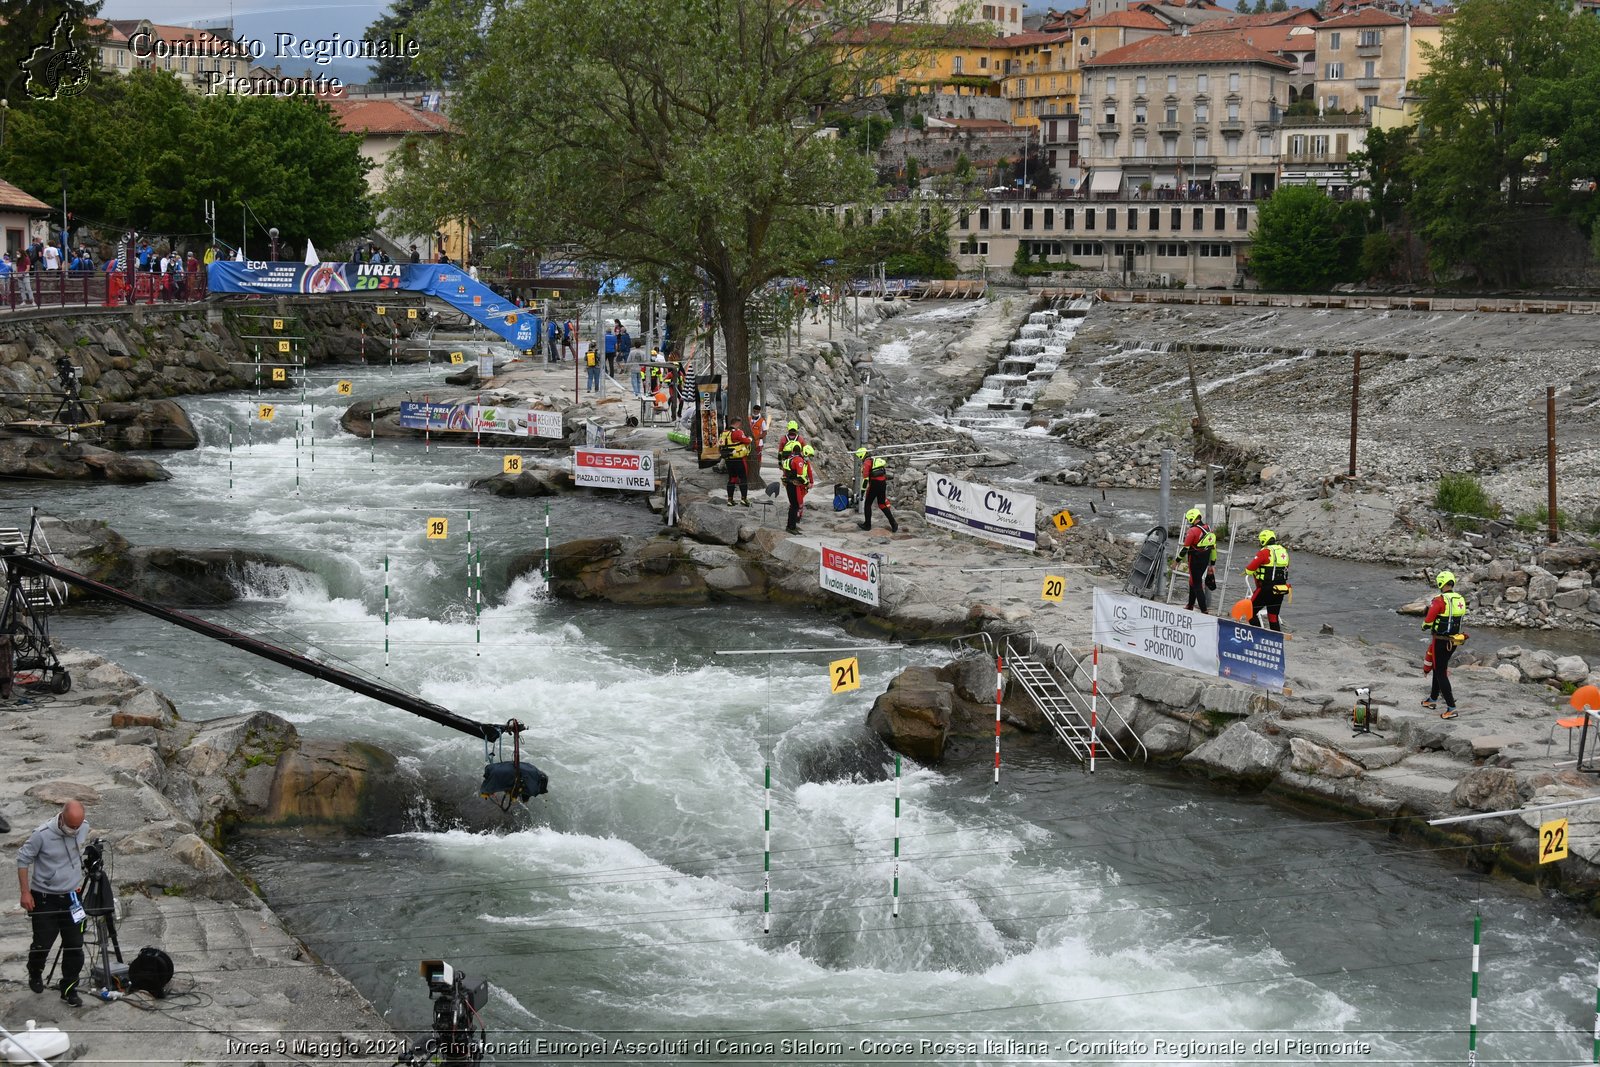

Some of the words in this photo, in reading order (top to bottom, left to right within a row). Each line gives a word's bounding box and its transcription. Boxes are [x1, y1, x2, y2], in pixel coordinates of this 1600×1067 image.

[247, 261, 268, 270] ECA
[357, 264, 401, 276] IVREA
[356, 275, 400, 289] 2021
[453, 354, 461, 362] 15
[340, 383, 349, 392] 16
[262, 408, 271, 417] 17
[537, 414, 561, 427] REGIONE
[537, 426, 561, 438] PIEMONTE
[507, 459, 518, 470] 18
[586, 455, 640, 468] DESPAR
[576, 474, 594, 482] PIAZZA
[626, 476, 651, 488] IVREA
[431, 521, 444, 535] 19
[828, 553, 868, 576] DESPAR
[844, 581, 857, 596] della
[1045, 580, 1061, 597] 20
[1113, 605, 1128, 620] ICS
[1140, 604, 1175, 625] ISTITUTO
[1176, 613, 1193, 630] PER
[1153, 624, 1160, 638] IL
[1161, 627, 1196, 648] CREDITO
[1234, 626, 1254, 643] ECA
[1144, 638, 1184, 661] SPORTIVO
[1254, 643, 1282, 656] SLALOM
[1261, 638, 1283, 649] CANOE
[1223, 652, 1279, 671] CHAMPIONSHIPS
[1244, 648, 1280, 663] EUROPEAN
[835, 664, 855, 686] 21
[1543, 827, 1564, 856] 22
